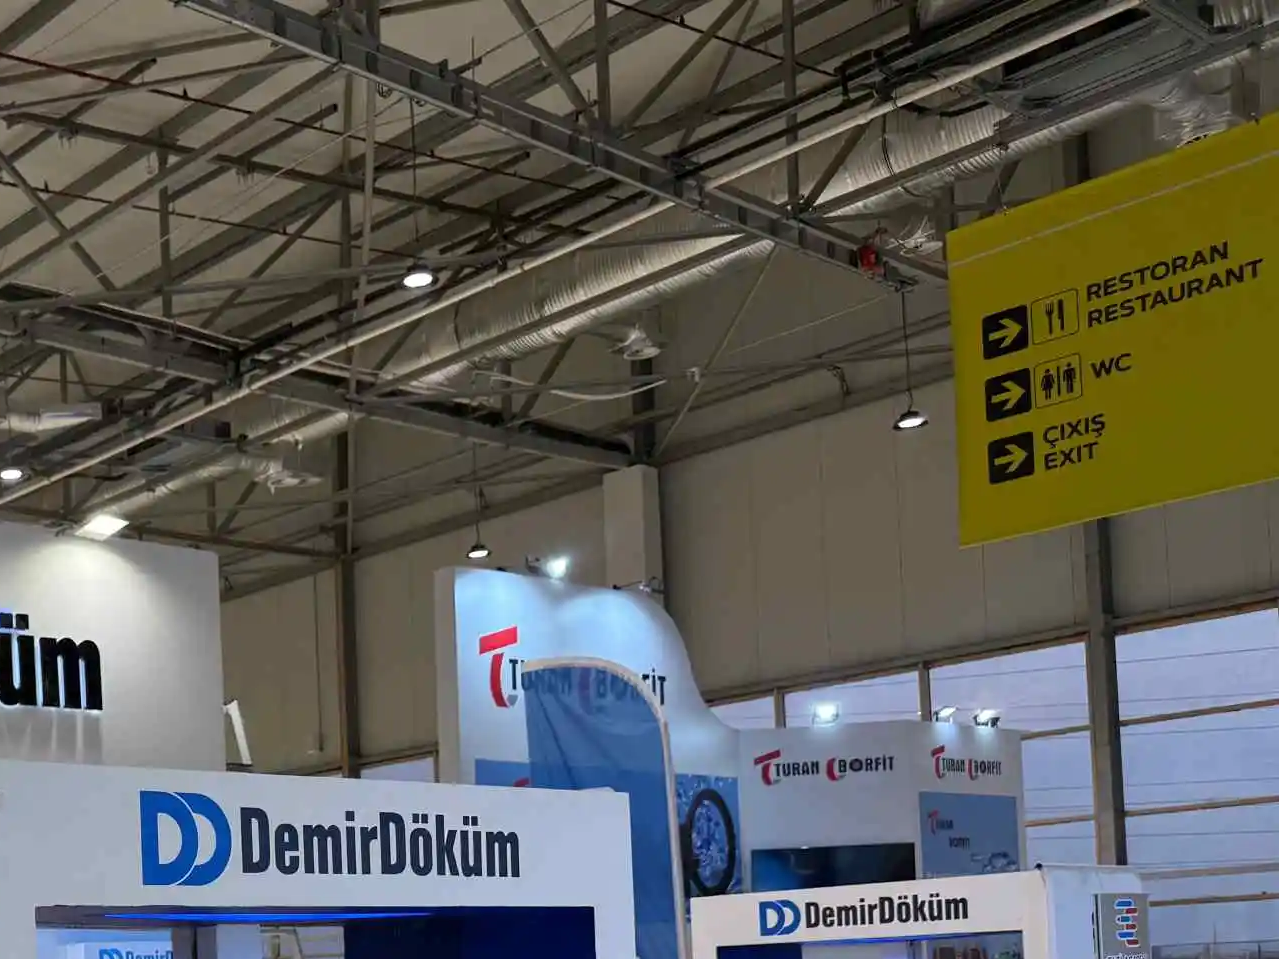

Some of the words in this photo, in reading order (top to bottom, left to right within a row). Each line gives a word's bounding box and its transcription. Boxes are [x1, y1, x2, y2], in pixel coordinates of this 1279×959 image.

[1086, 241, 1228, 300] RESTORAN
[1087, 258, 1263, 328] RESTAURANT
[1091, 354, 1132, 379] WC
[1043, 413, 1106, 448] ÇIXIŞ
[1044, 442, 1099, 471] EXIT
[240, 806, 520, 878] DemirDöküm
[805, 893, 968, 928] DemirDöküm
